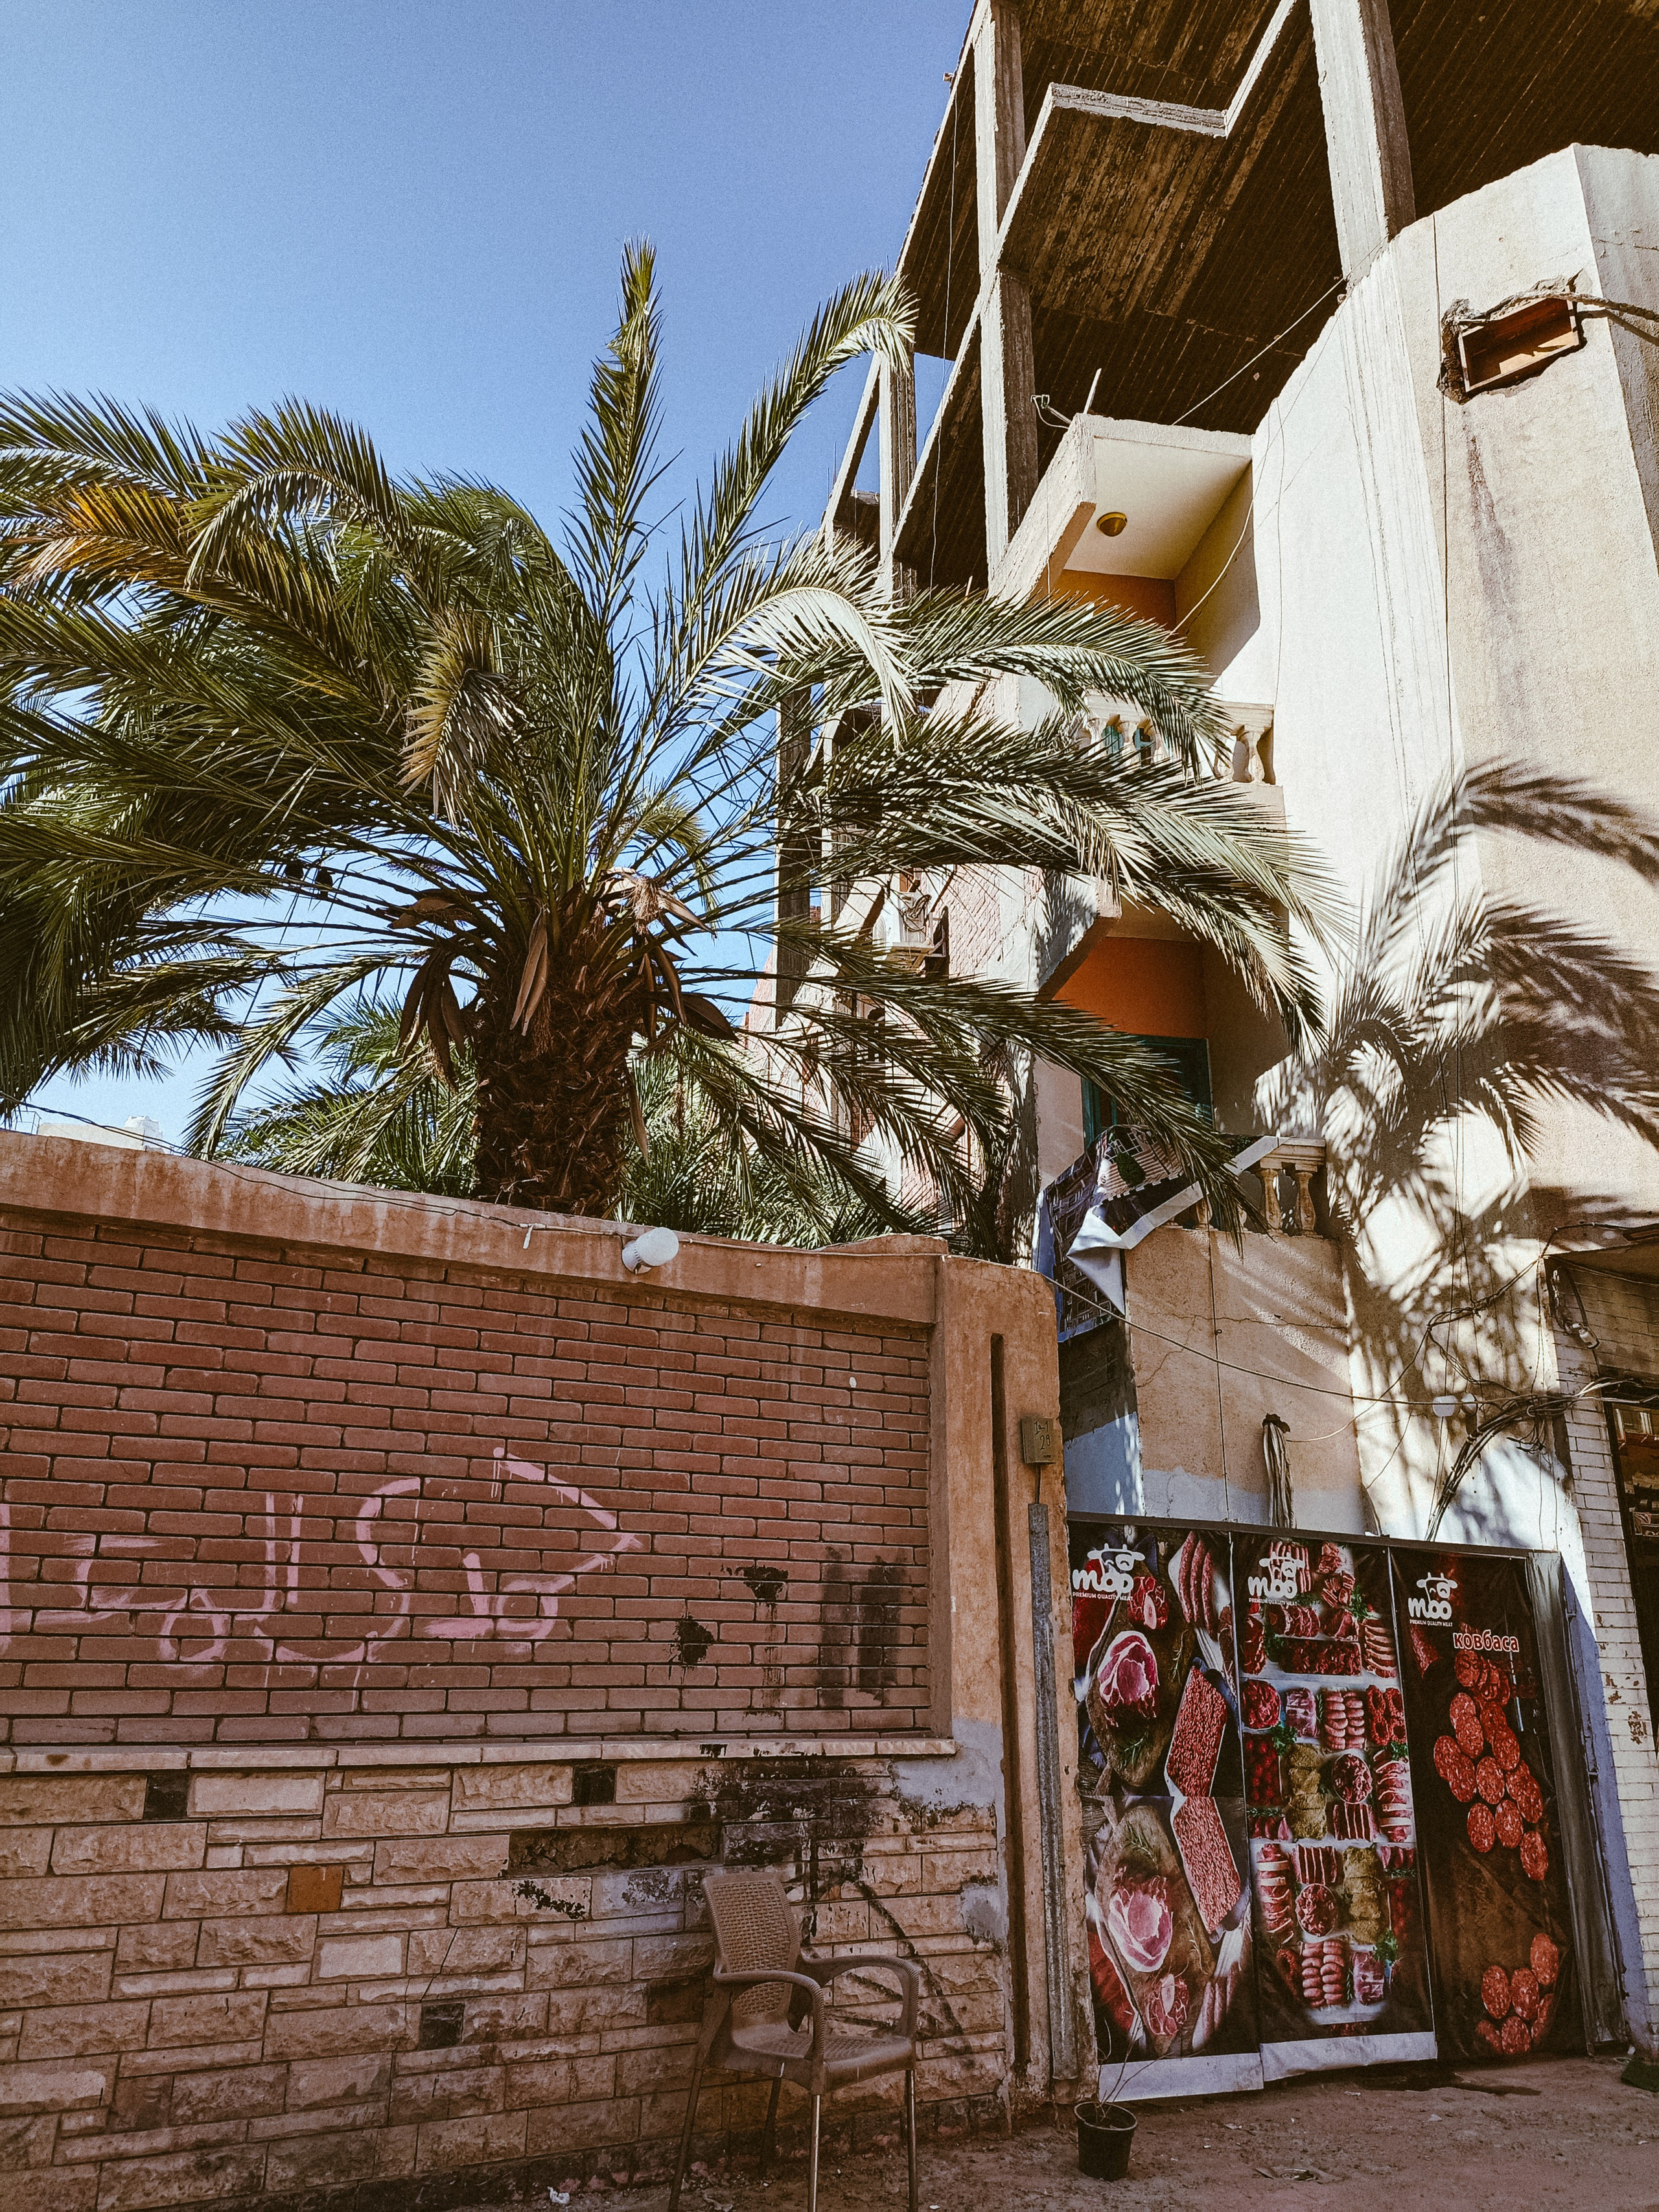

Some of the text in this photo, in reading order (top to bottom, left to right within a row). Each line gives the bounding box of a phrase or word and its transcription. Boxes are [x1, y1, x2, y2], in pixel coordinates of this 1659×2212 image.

[1072, 1569, 1134, 1594] moo
[1247, 1576, 1298, 1600] moo
[1408, 1597, 1452, 1620] moo
[1452, 1629, 1520, 1653] ковбаса
